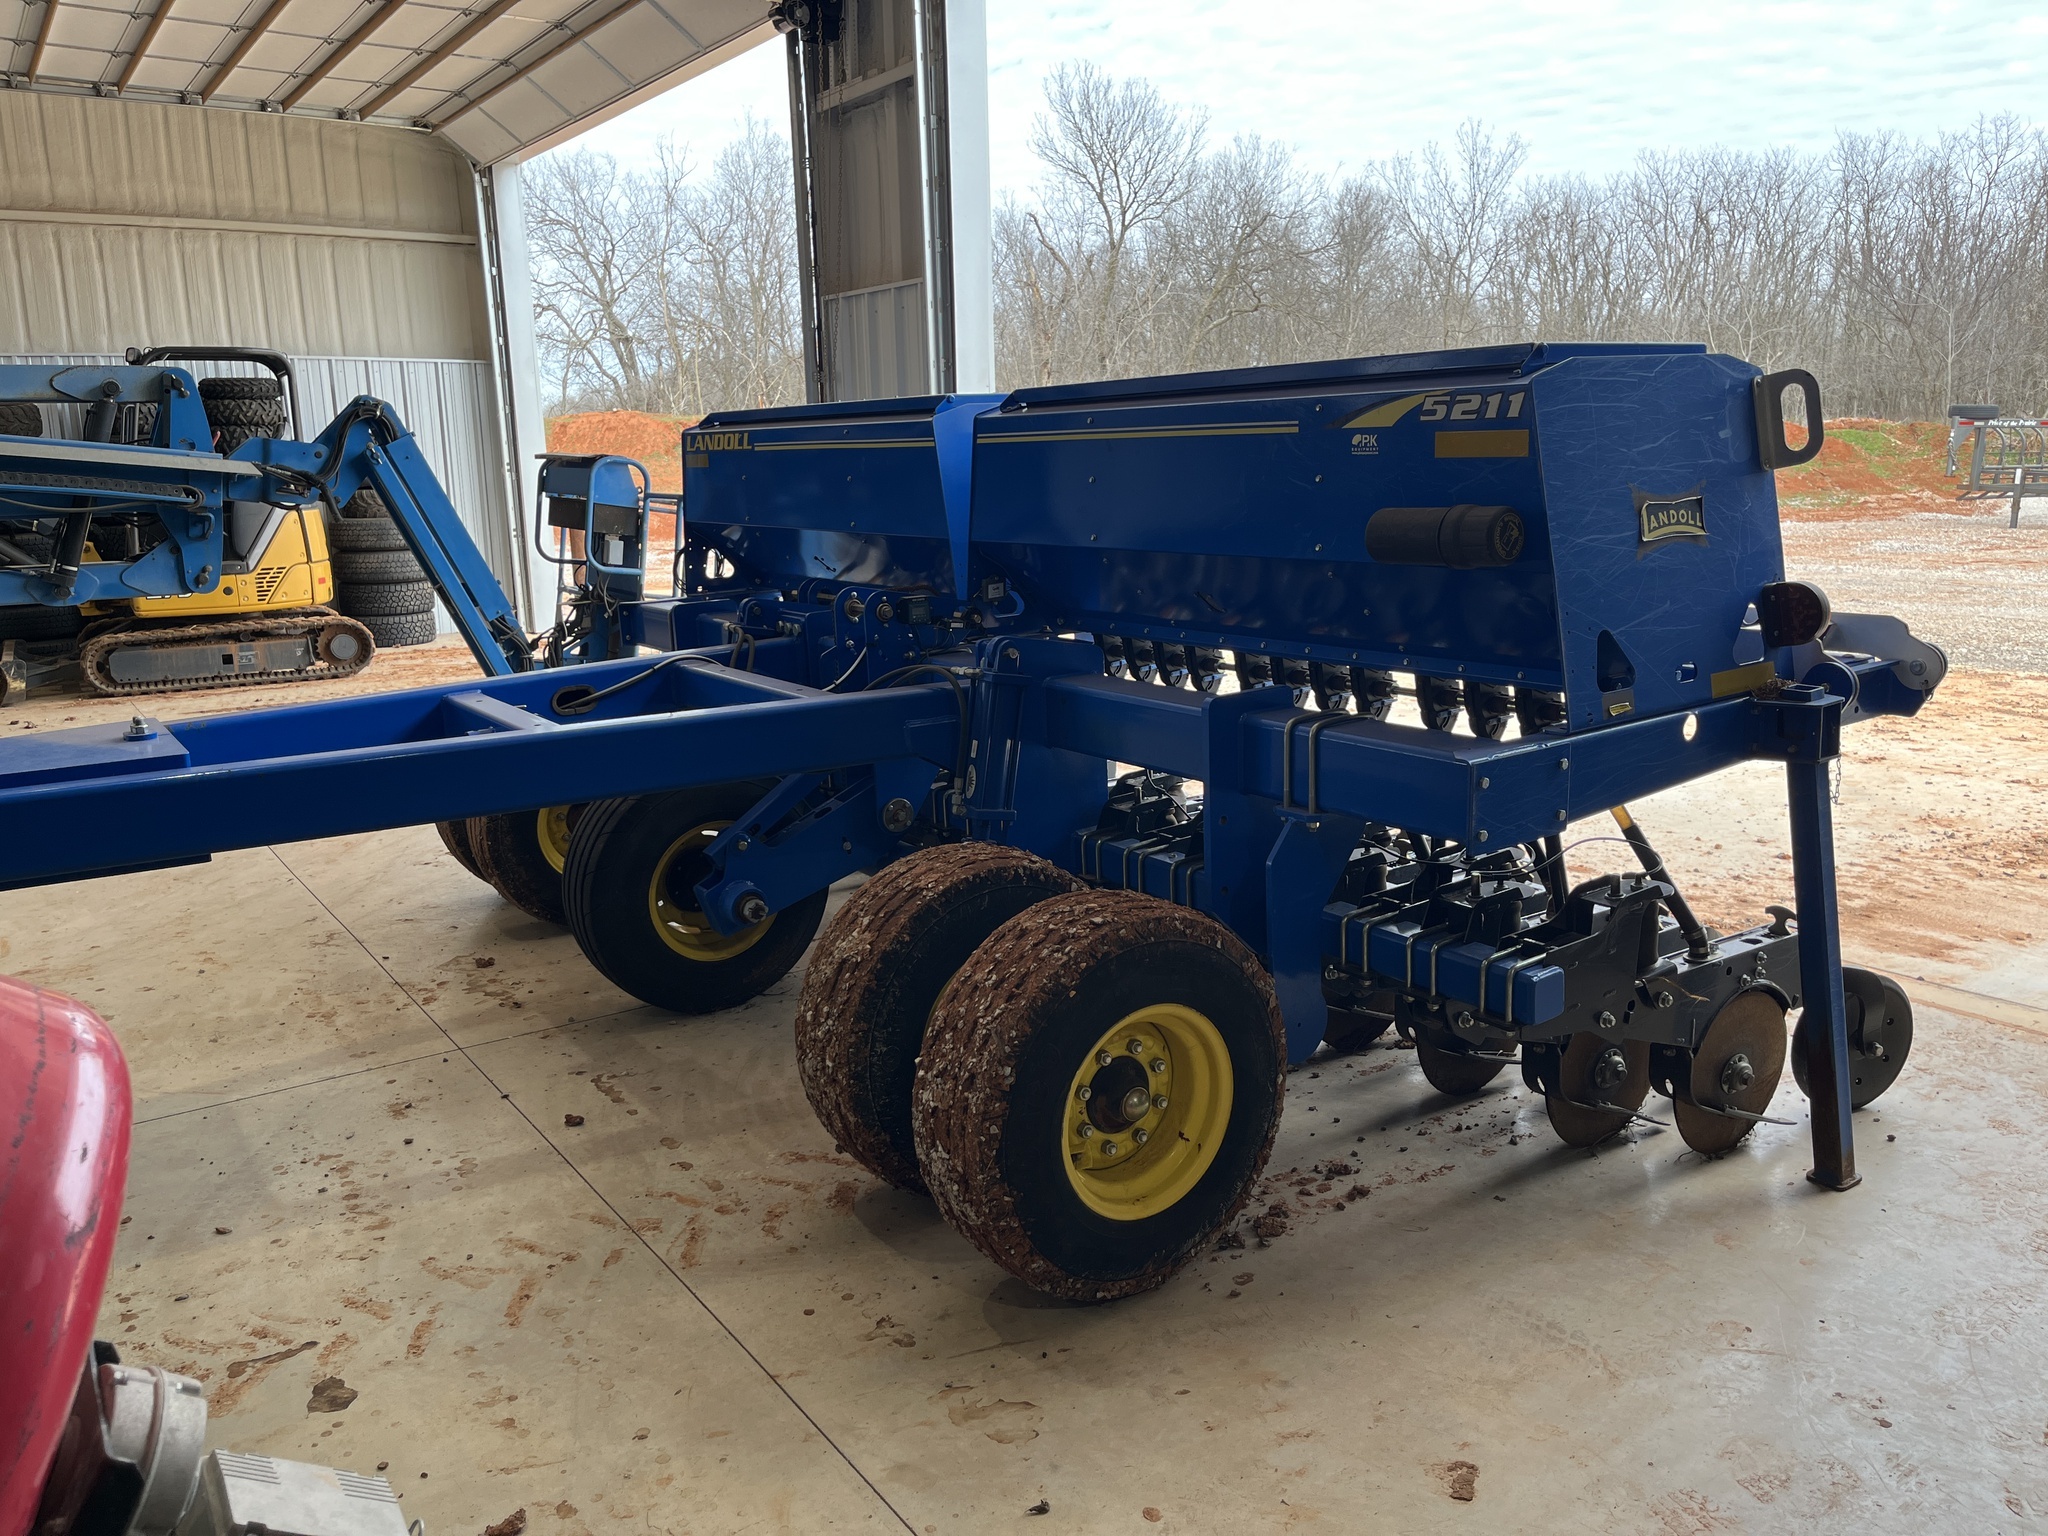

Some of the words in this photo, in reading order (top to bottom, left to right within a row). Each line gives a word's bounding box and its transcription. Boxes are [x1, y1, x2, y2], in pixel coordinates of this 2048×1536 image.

[1420, 391, 1526, 421] 5211
[686, 432, 752, 452] LANDOLL
[1642, 507, 1706, 540] LANDOLL
